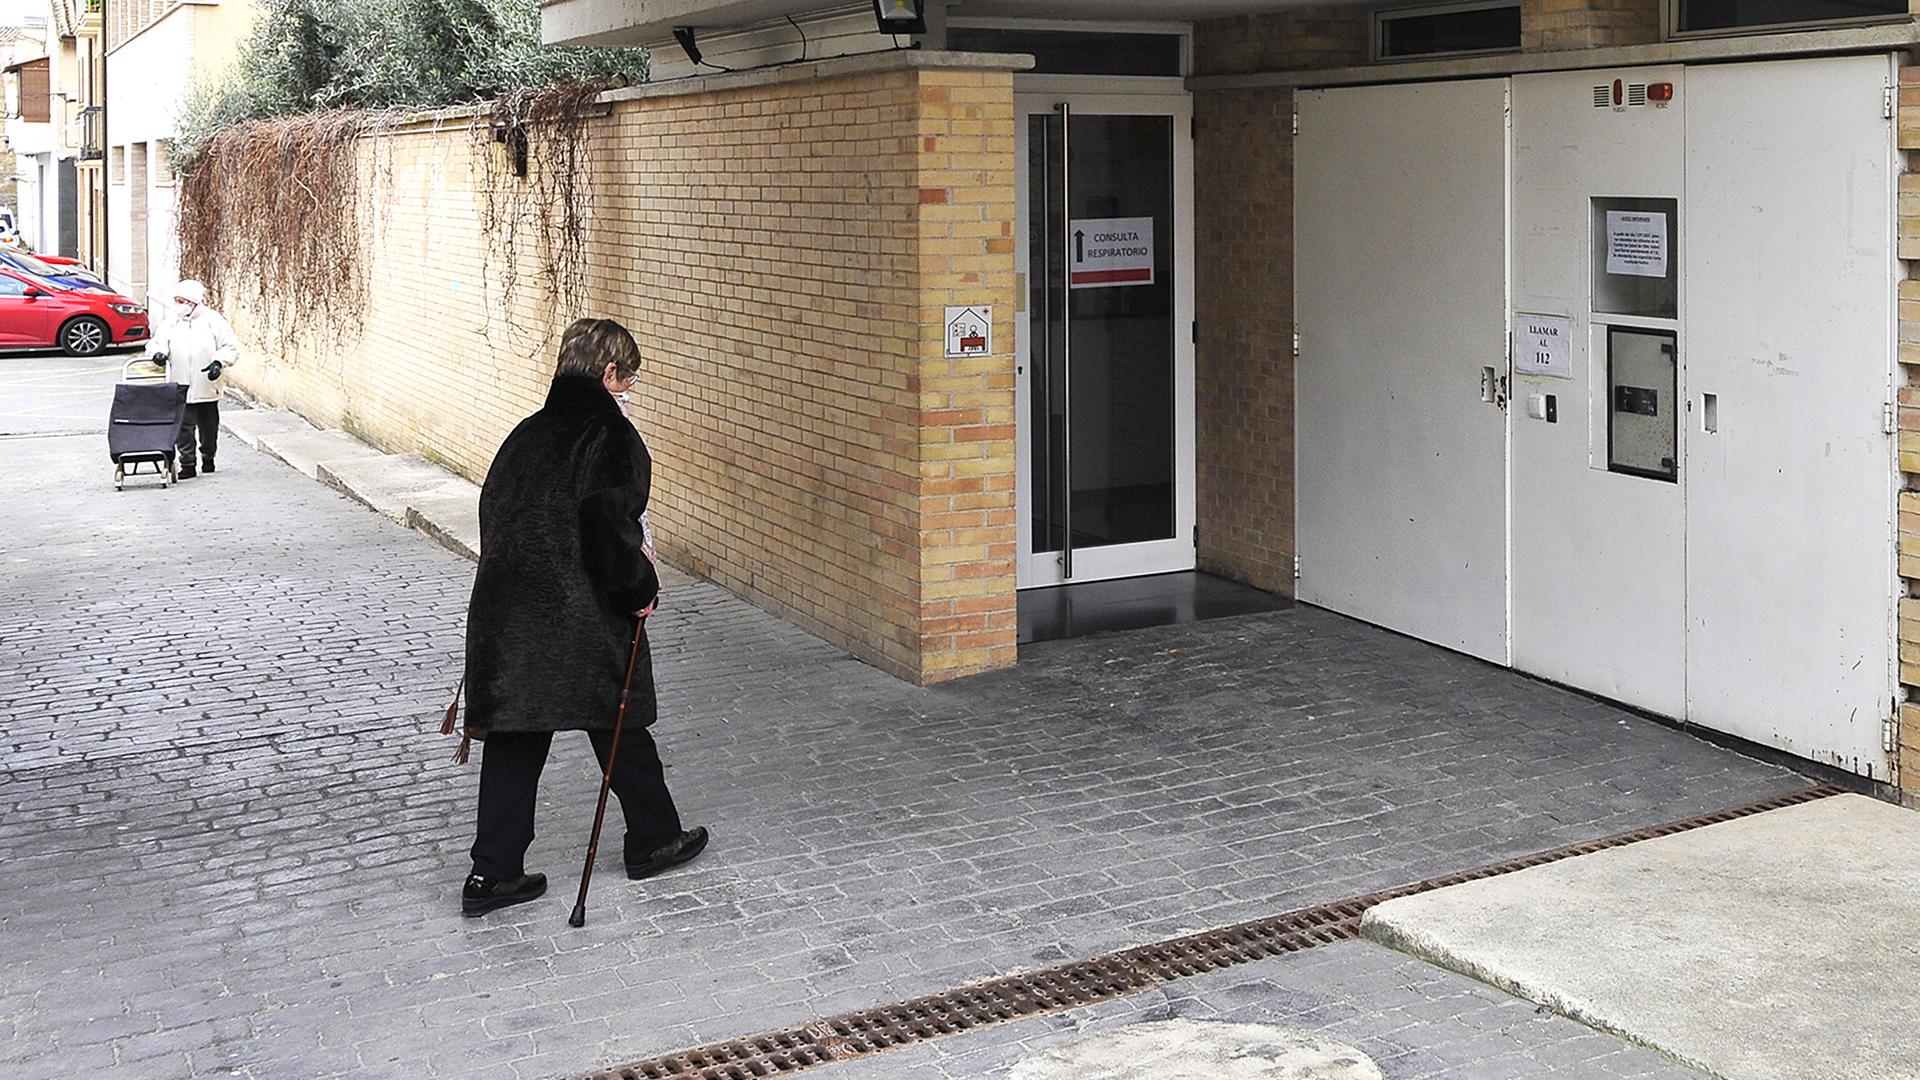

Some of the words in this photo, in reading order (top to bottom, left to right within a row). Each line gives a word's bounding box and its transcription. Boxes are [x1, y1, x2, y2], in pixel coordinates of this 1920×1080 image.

[1093, 232, 1139, 242] CONSULTA
[1087, 247, 1148, 258] RESPIRATORIO
[1529, 325, 1559, 336] LLAMAR
[1539, 339, 1548, 347] AL
[1535, 352, 1550, 365] 112
